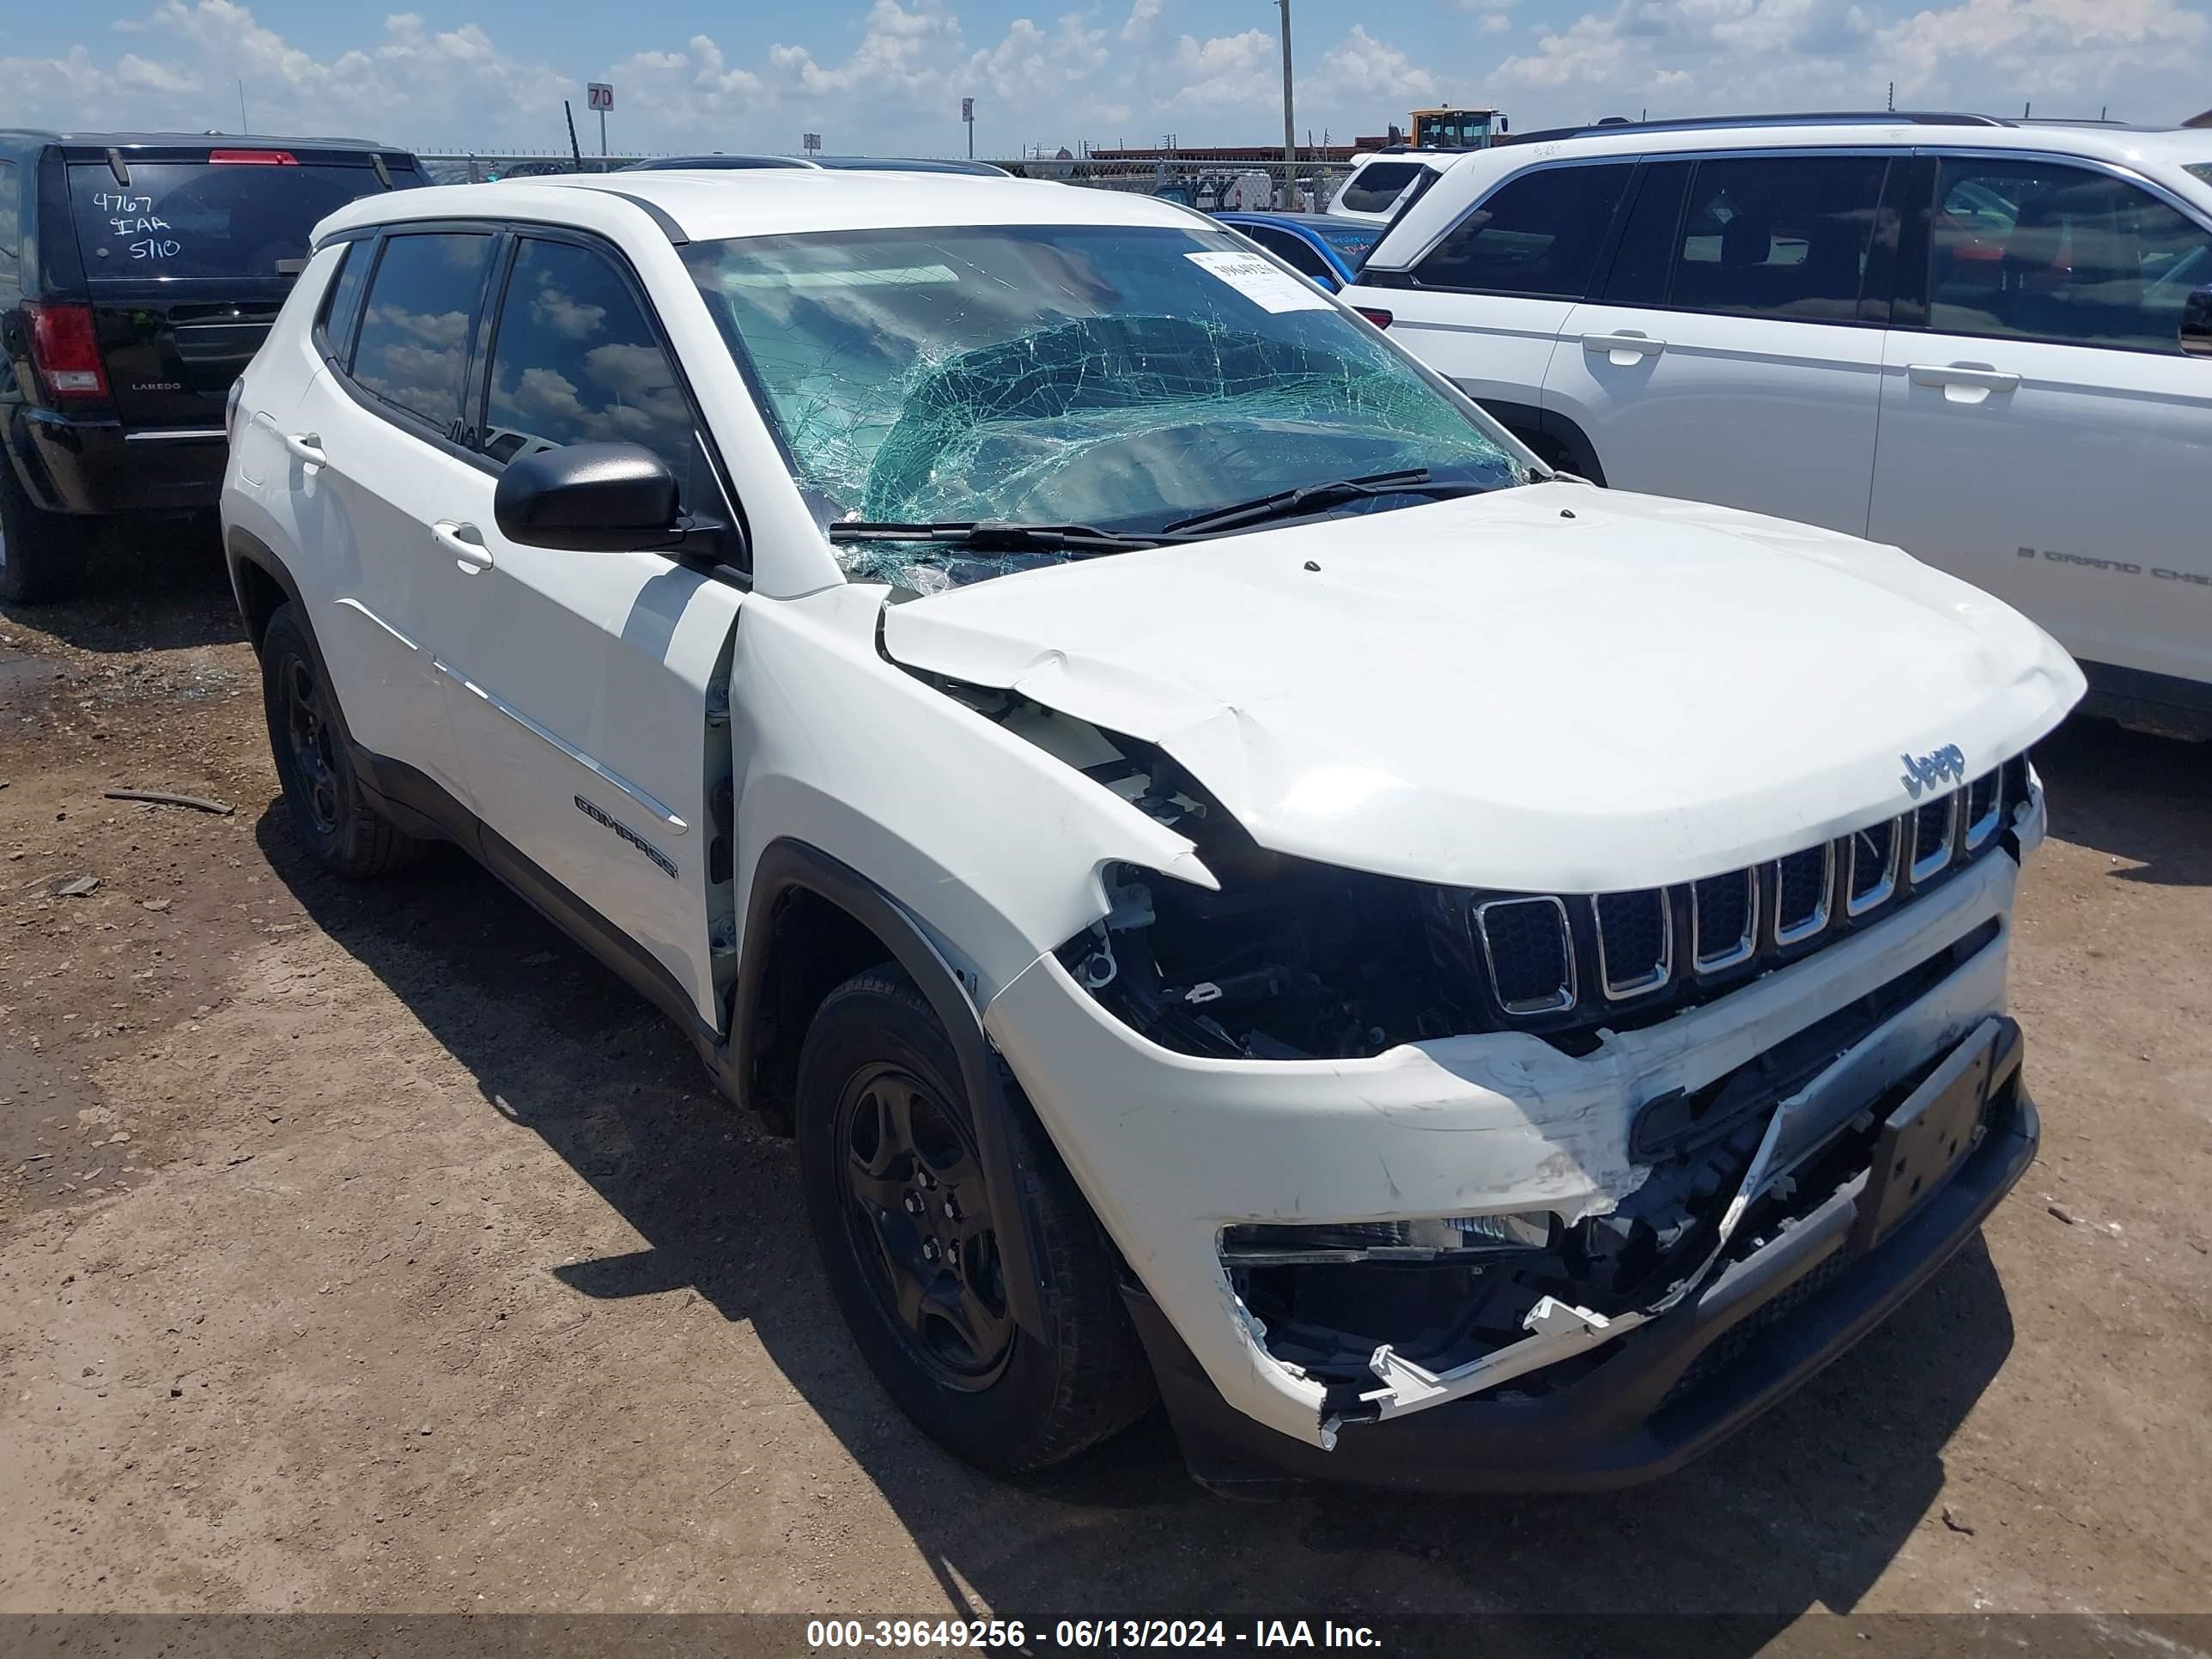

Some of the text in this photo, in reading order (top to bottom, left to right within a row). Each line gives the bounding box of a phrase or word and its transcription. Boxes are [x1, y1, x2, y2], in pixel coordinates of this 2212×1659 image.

[94, 193, 151, 212] 4767
[130, 239, 180, 259] 5710
[132, 382, 181, 391] LAREDO
[2044, 550, 2212, 586] GRAND CHE
[1900, 744, 1965, 796] Jeep
[574, 793, 678, 879] COMPASS
